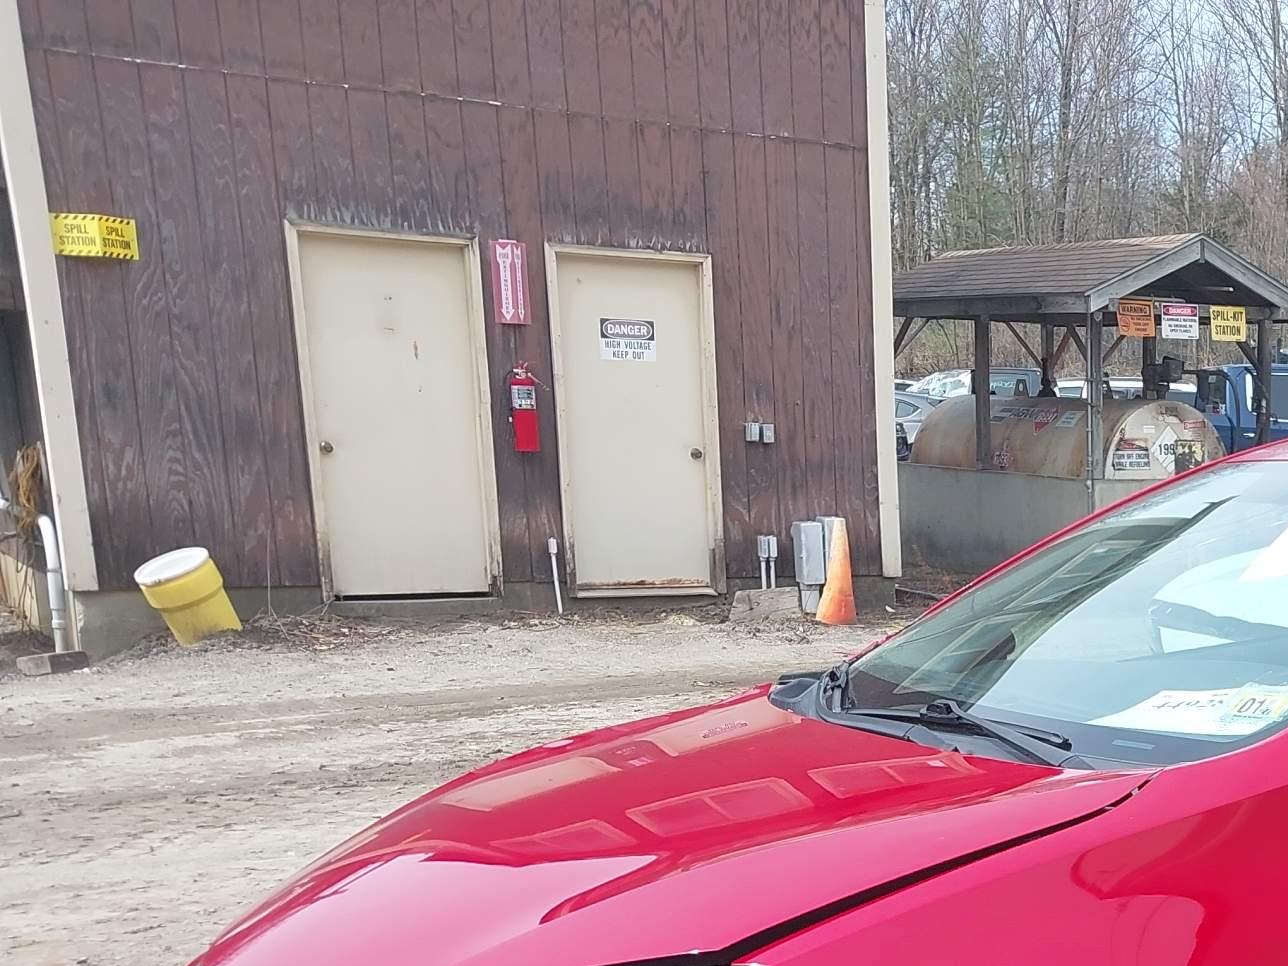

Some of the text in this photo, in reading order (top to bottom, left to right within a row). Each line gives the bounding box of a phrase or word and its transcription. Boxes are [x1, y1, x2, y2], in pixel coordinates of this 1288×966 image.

[64, 223, 89, 234] SPILL
[105, 226, 125, 238] SPILL
[59, 236, 97, 247] STATION
[102, 238, 131, 250] STATION
[1120, 304, 1148, 314] WARNING
[1212, 310, 1244, 322] SPILL-KIT
[608, 324, 648, 336] DANGER
[1214, 324, 1241, 336] STATION
[604, 340, 652, 350] HIGH VOLTAGE
[612, 350, 644, 360] KEEP OUT
